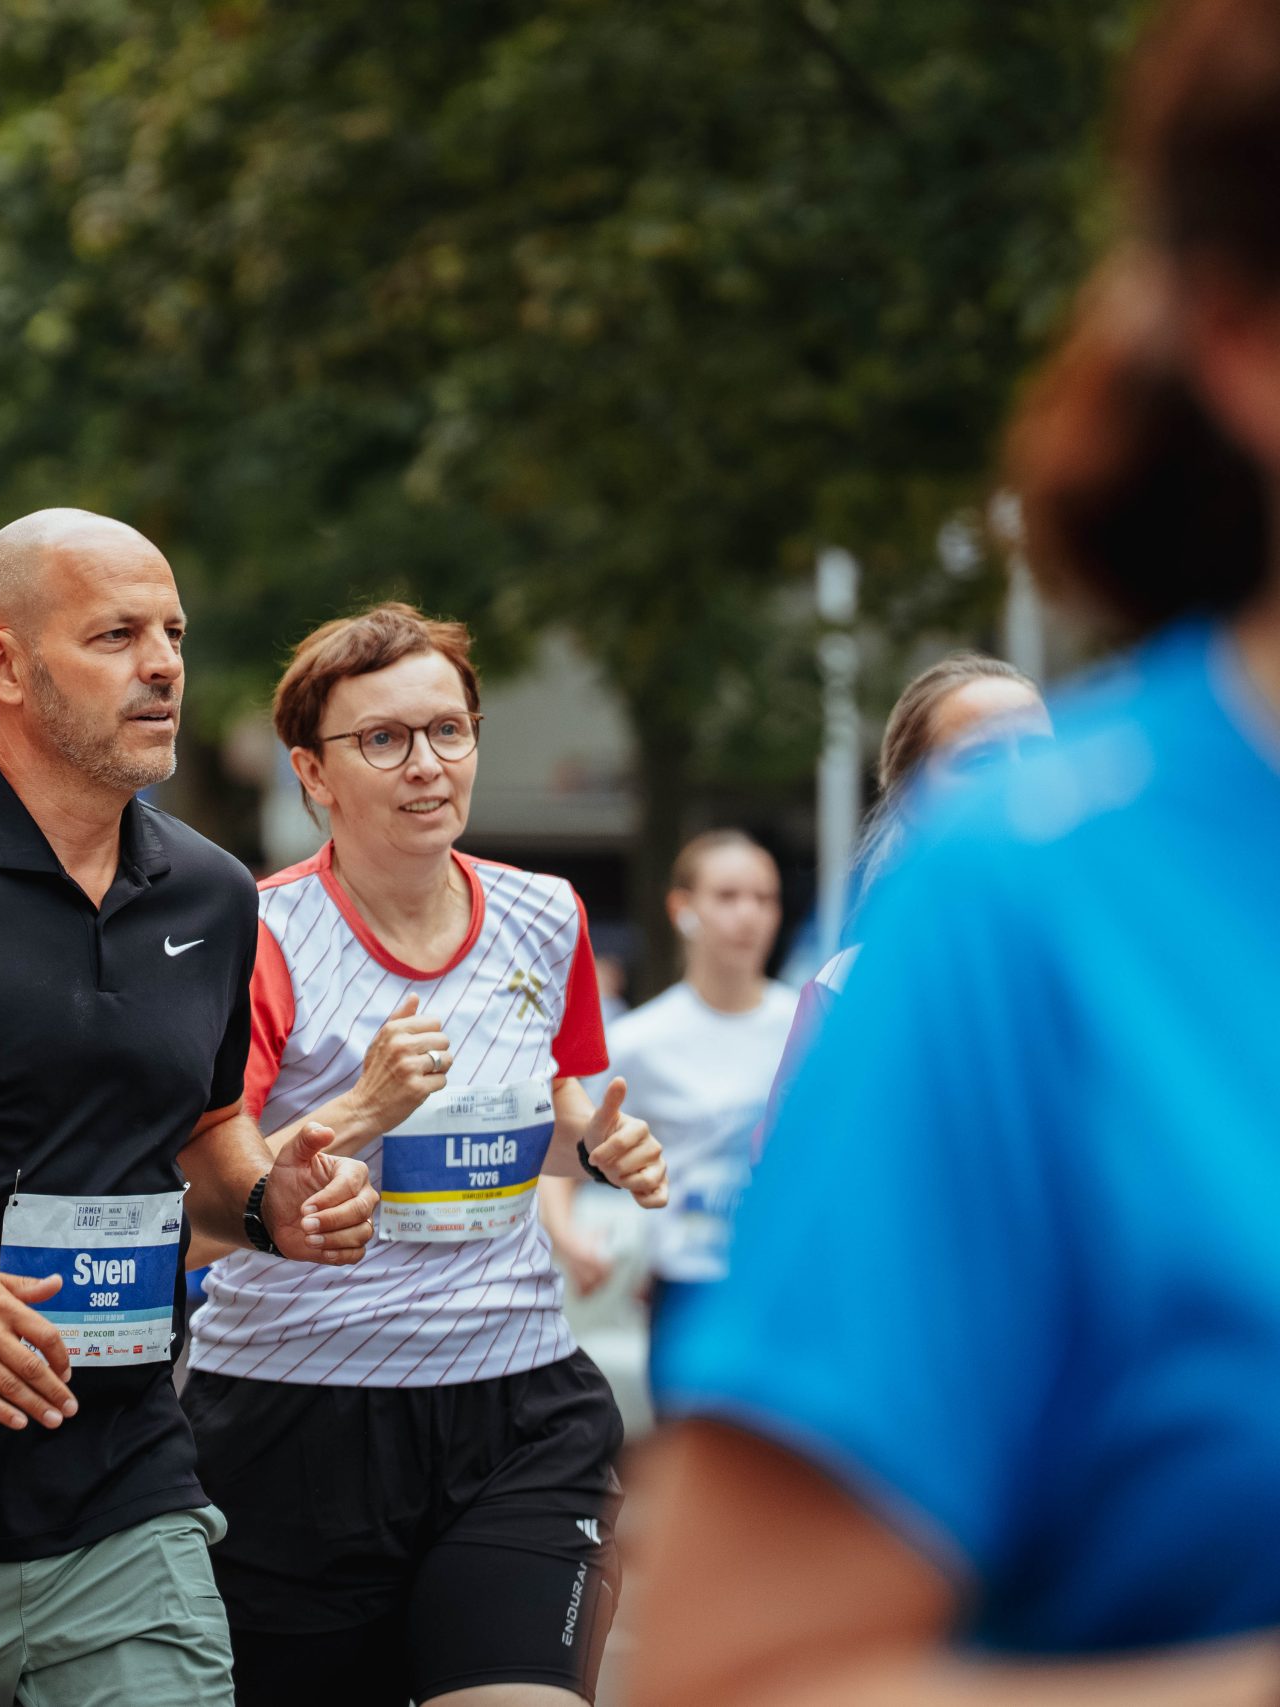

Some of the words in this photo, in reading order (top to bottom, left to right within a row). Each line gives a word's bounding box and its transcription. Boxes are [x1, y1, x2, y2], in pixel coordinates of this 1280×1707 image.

[445, 1135, 517, 1168] Linda
[78, 1206, 101, 1214] FIRMEN
[77, 1215, 100, 1227] LAUF
[72, 1252, 136, 1286] Sven
[89, 1292, 119, 1308] 3802
[87, 1343, 100, 1353] dm
